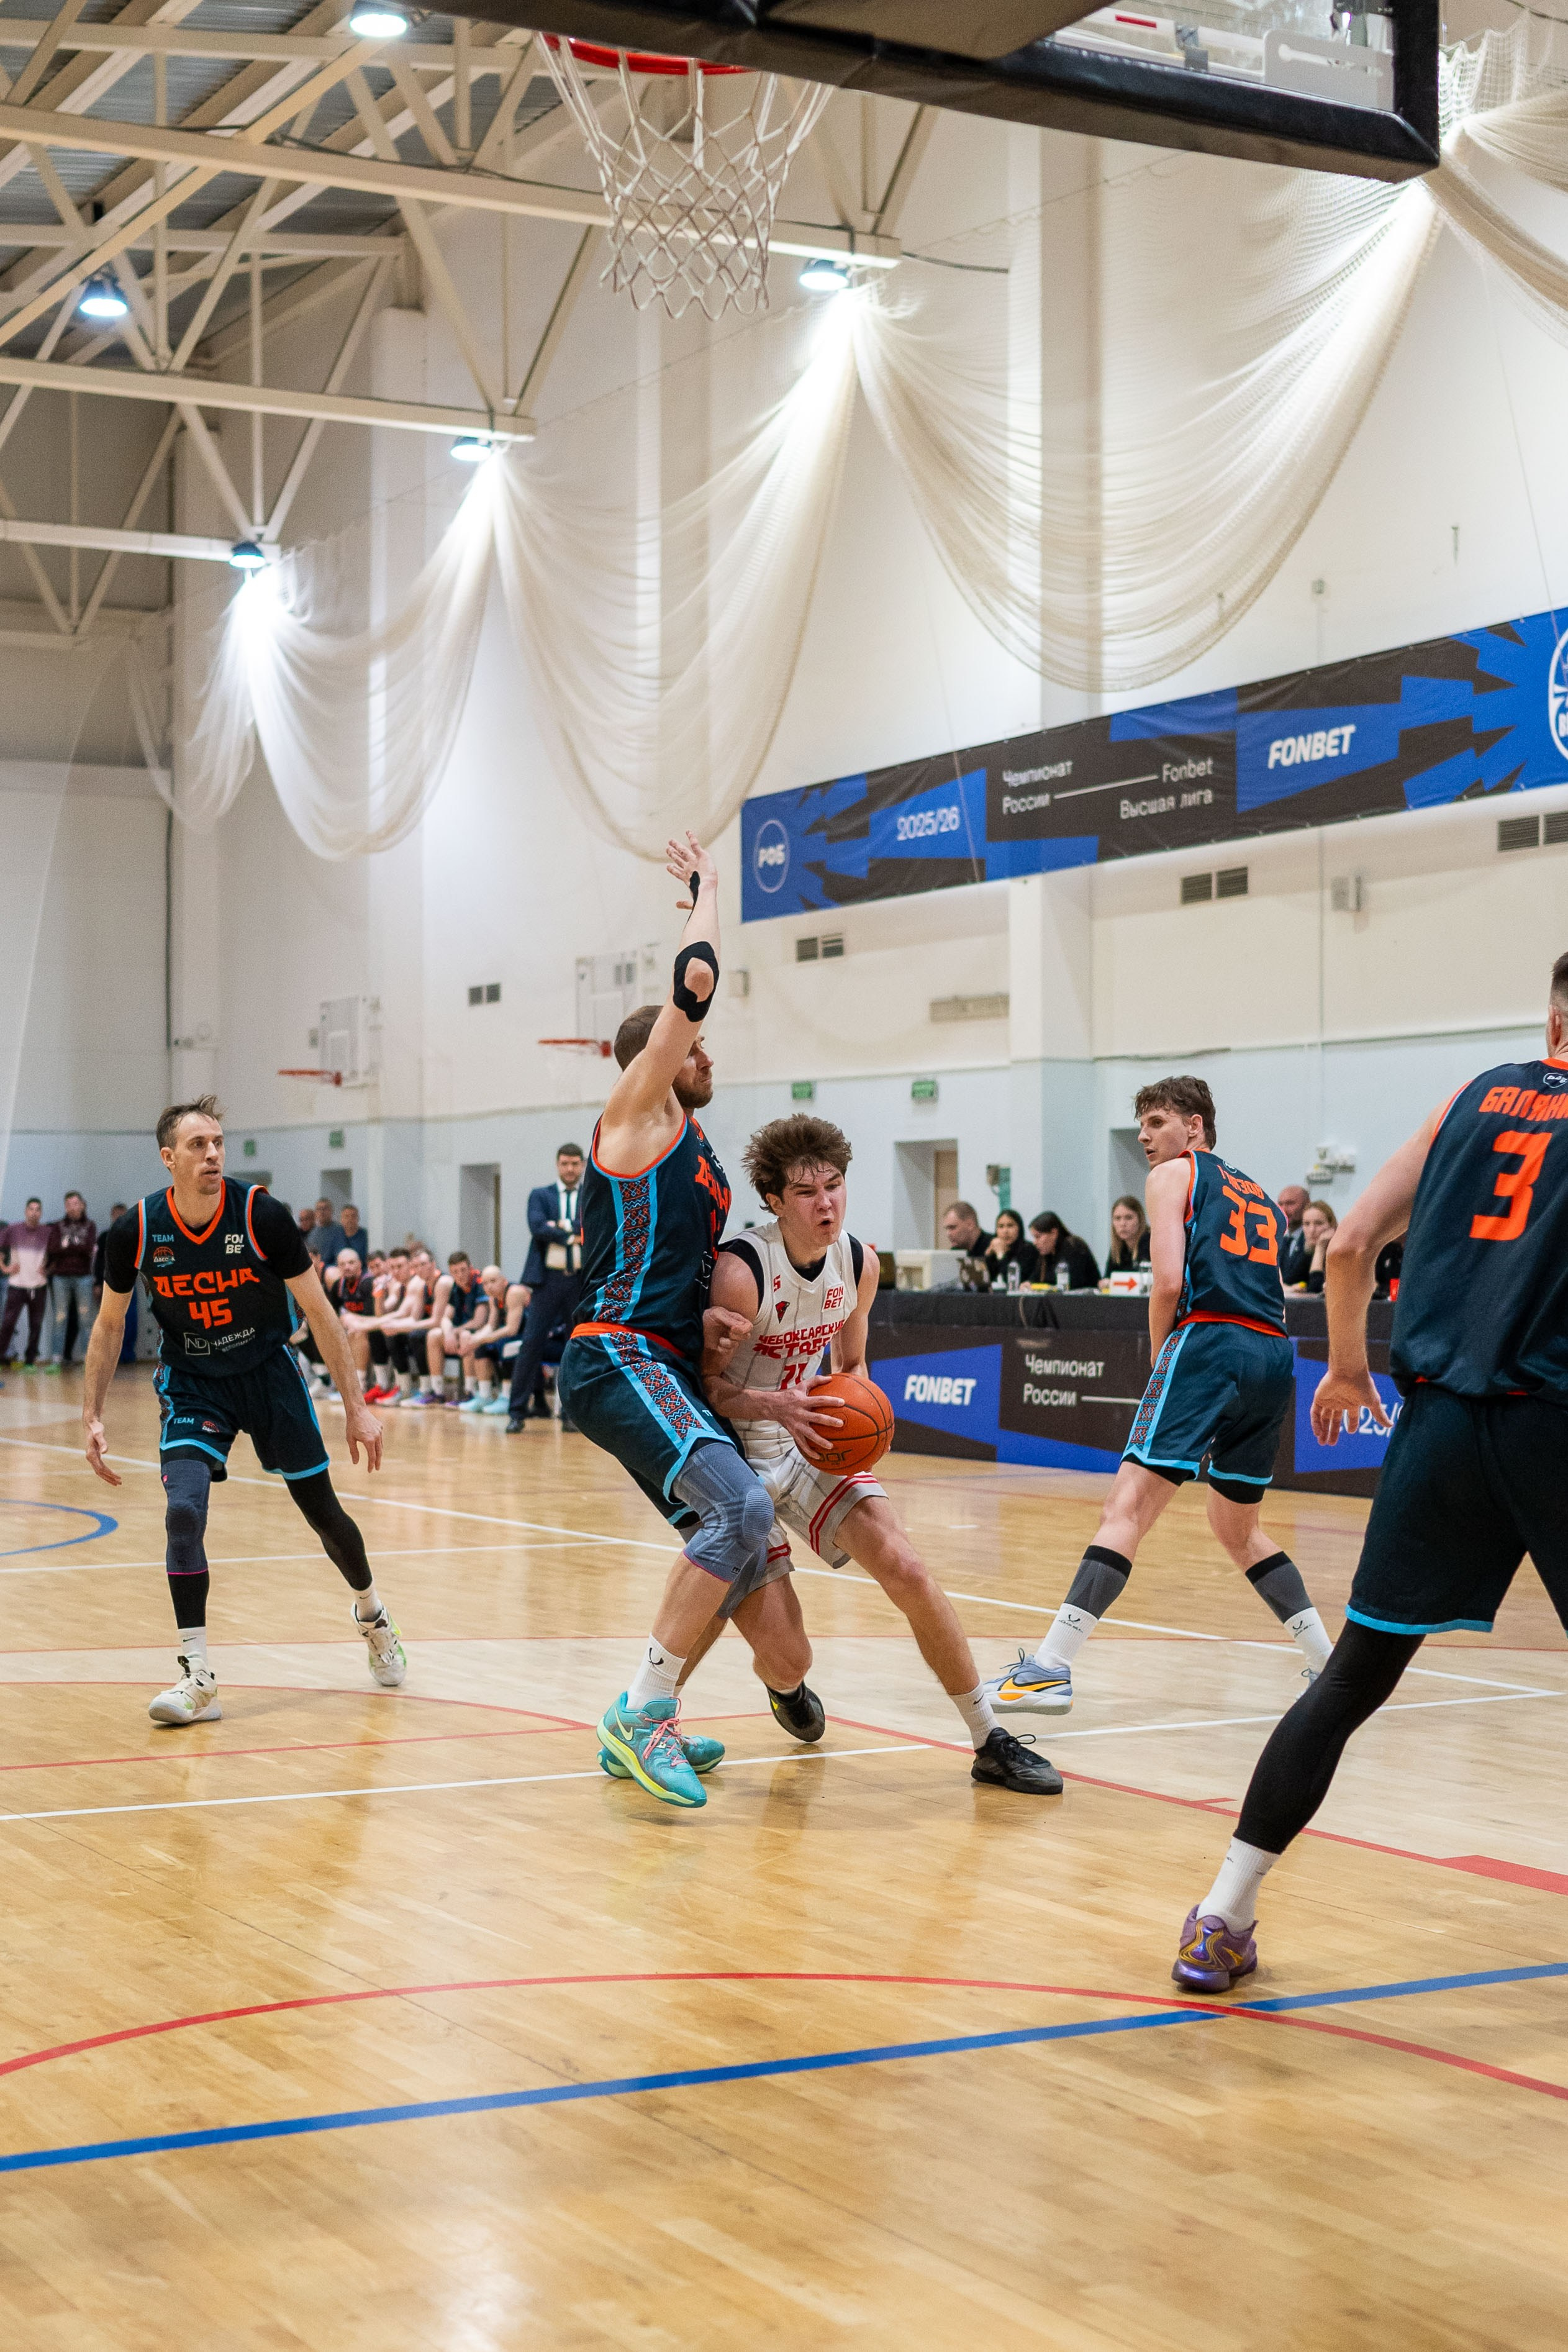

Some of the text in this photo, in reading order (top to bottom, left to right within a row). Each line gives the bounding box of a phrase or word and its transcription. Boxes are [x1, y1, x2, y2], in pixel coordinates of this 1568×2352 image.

[1267, 724, 1356, 770] FONBET
[1003, 761, 1073, 788] Чемпионат
[1003, 758, 1213, 815] России Fonbet
[1120, 789, 1213, 819] Высшая лига
[897, 806, 960, 841] 2025/26
[1469, 1130, 1552, 1241] 3
[152, 1234, 174, 1243] TEAM
[1220, 1185, 1278, 1266] 33
[153, 1268, 260, 1297] ДЕСНА
[827, 1286, 844, 1299] FON
[188, 1298, 233, 1329] 45
[823, 1297, 843, 1310] BET
[1025, 1354, 1104, 1378] Чемпионат
[904, 1374, 976, 1405] FONBET
[1024, 1383, 1077, 1406] России
